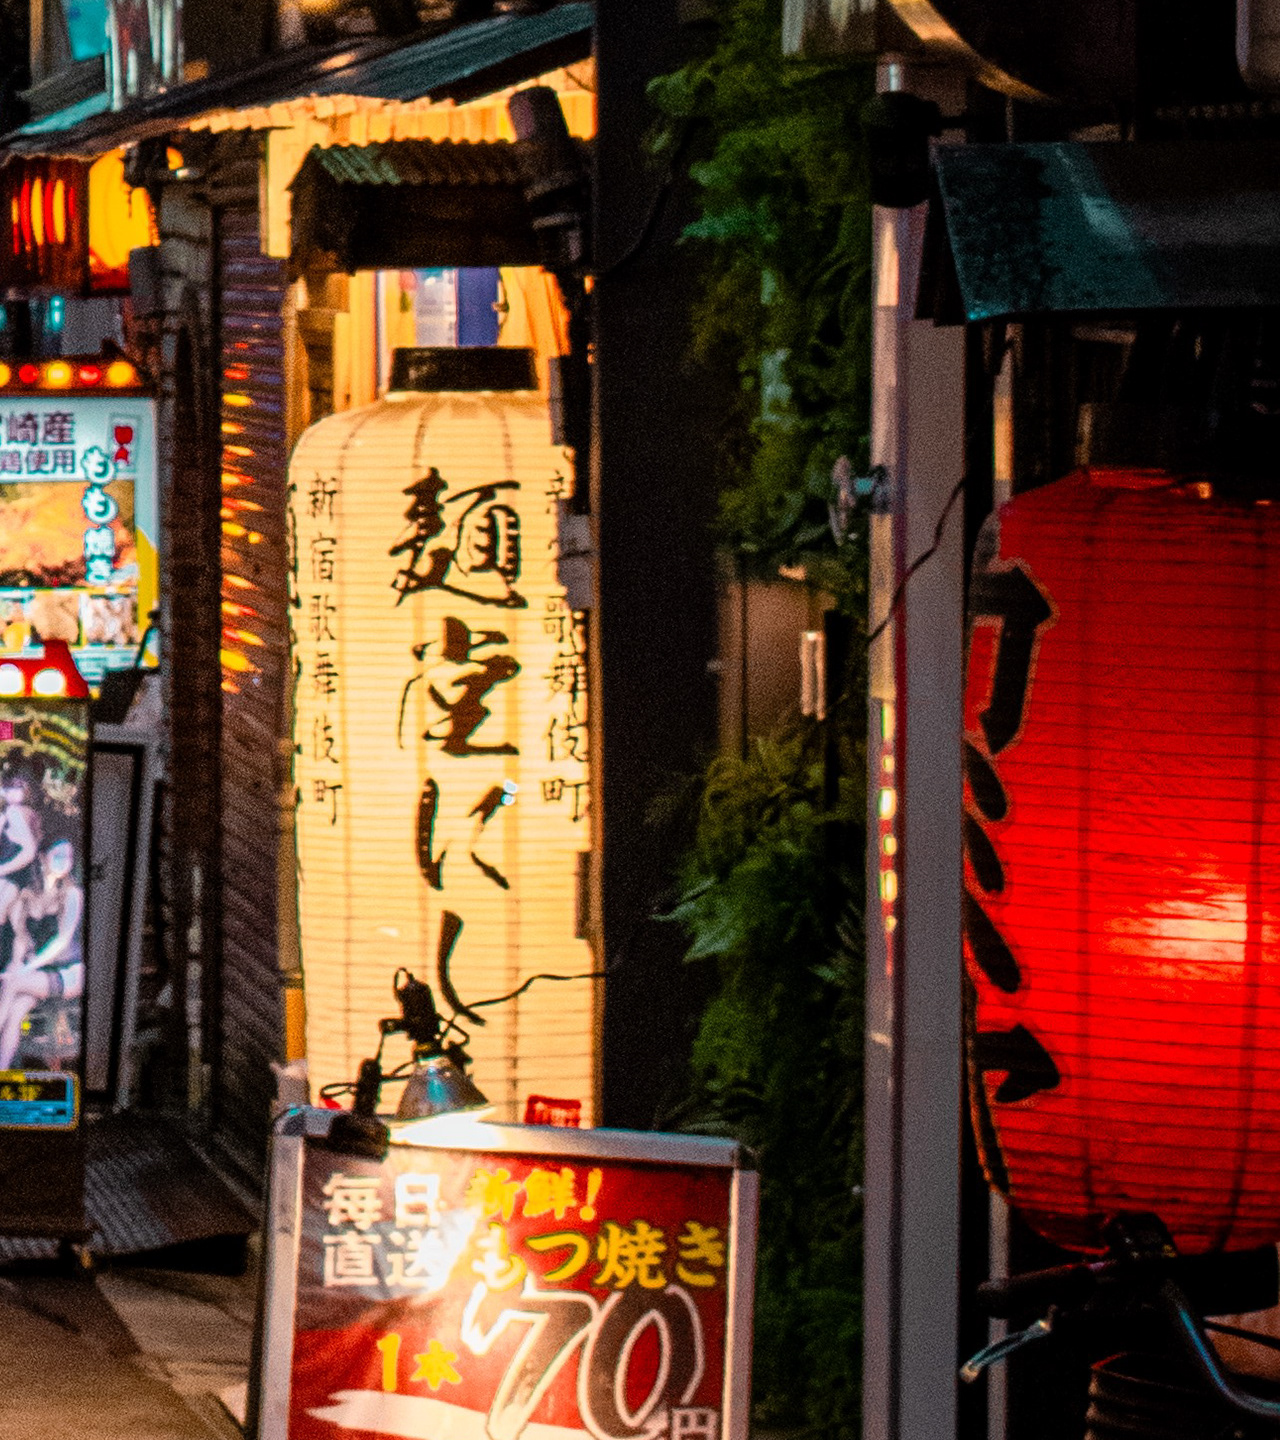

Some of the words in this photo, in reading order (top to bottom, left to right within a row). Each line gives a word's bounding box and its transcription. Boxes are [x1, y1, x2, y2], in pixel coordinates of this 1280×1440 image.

[309, 470, 344, 827] 新宿歌舞伎町
[322, 1172, 443, 1231] 毎日
[472, 1221, 726, 1293] もつ焼き
